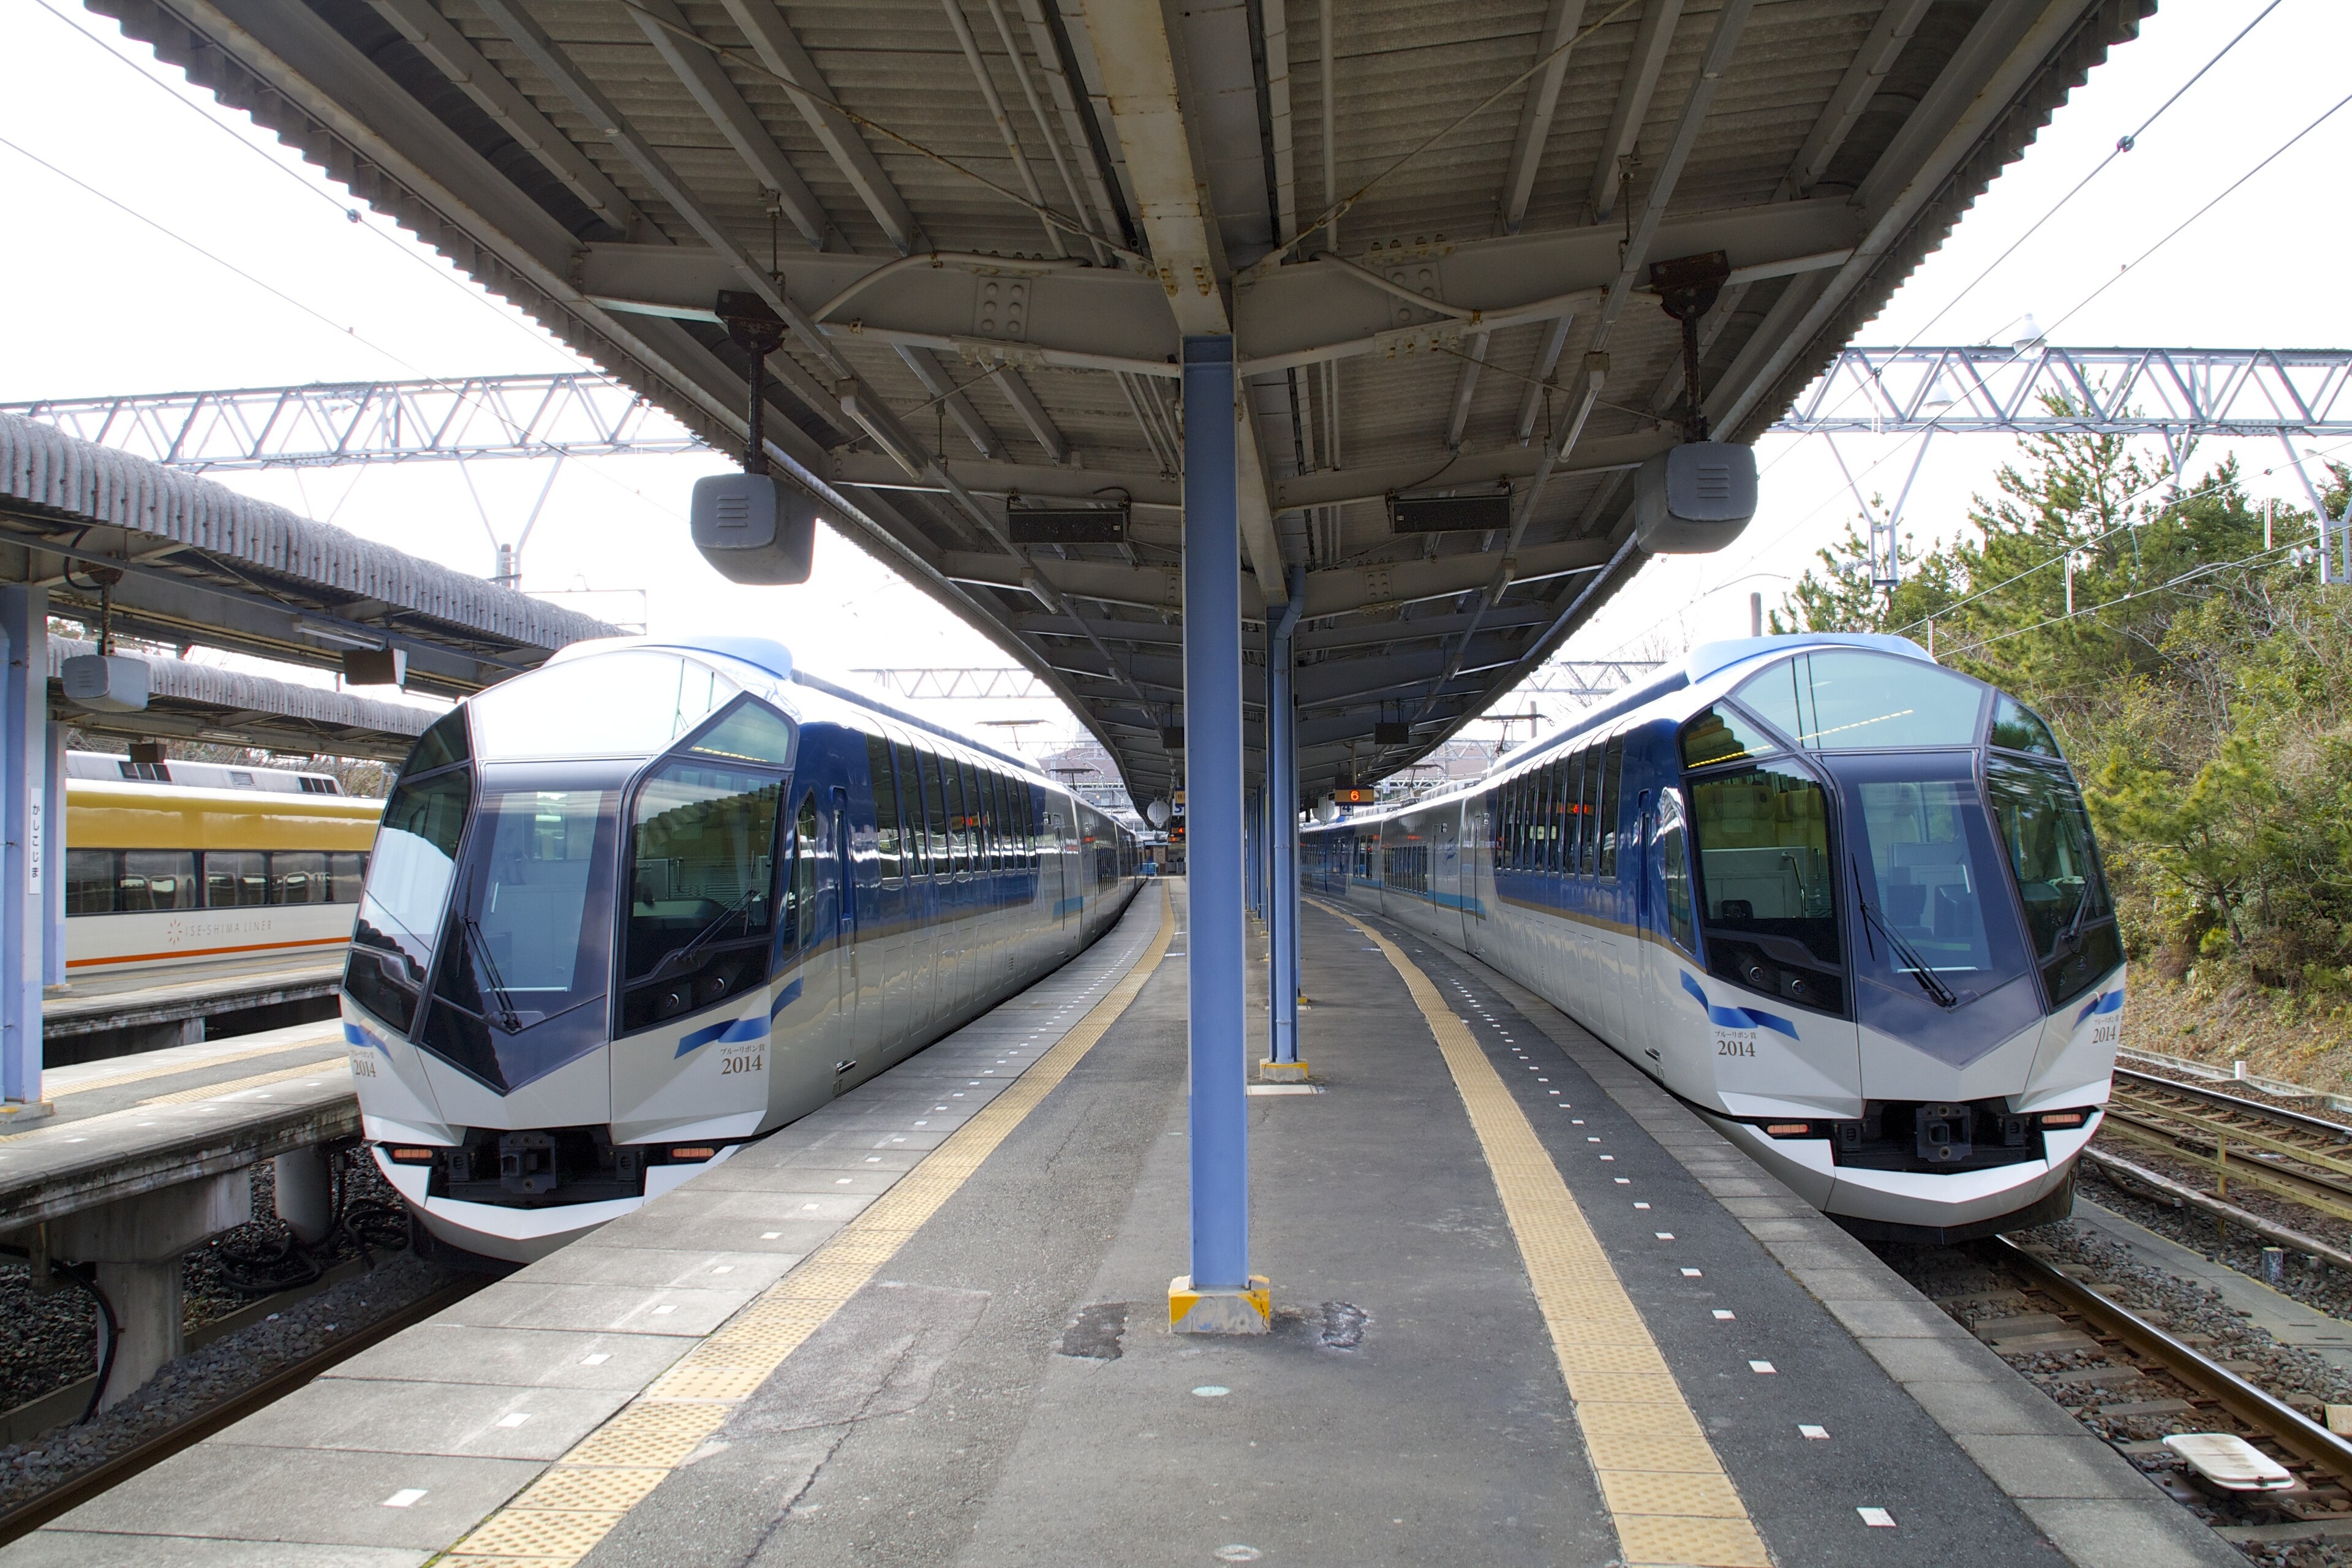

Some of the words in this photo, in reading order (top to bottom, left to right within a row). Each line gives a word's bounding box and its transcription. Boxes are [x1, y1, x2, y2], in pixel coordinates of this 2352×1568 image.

[1351, 791, 1359, 801] 6
[186, 923, 240, 937] ISE-SHIMA
[244, 920, 272, 932] LINER
[1715, 1031, 1757, 1039] ブルーリボン賞
[2092, 1025, 2116, 1044] 2014
[720, 1044, 765, 1055] ブルーリボン賞
[1717, 1040, 1755, 1057] 2014
[353, 1060, 377, 1077] 2014
[721, 1054, 763, 1075] 2014
